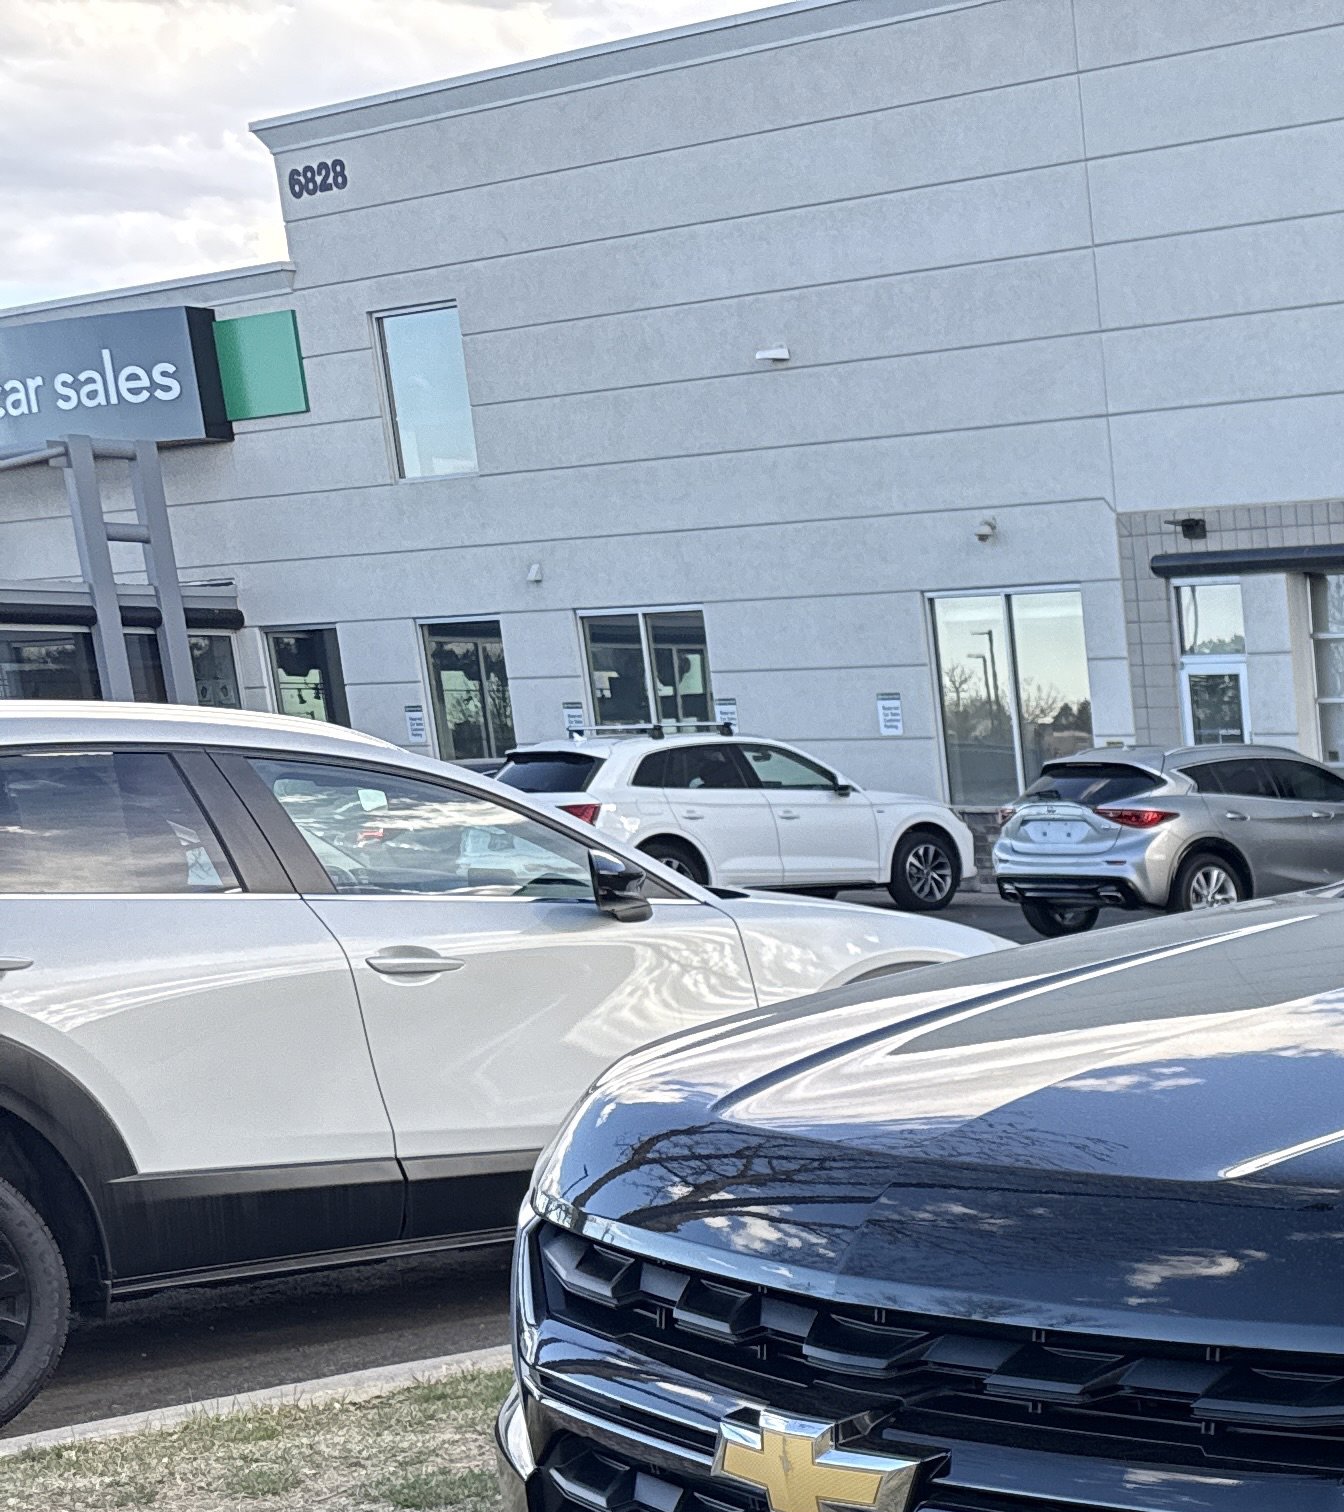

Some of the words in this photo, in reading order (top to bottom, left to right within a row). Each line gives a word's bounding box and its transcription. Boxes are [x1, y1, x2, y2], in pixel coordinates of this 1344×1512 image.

[288, 158, 348, 199] 6828
[0, 376, 43, 417] ar
[55, 349, 182, 411] sales
